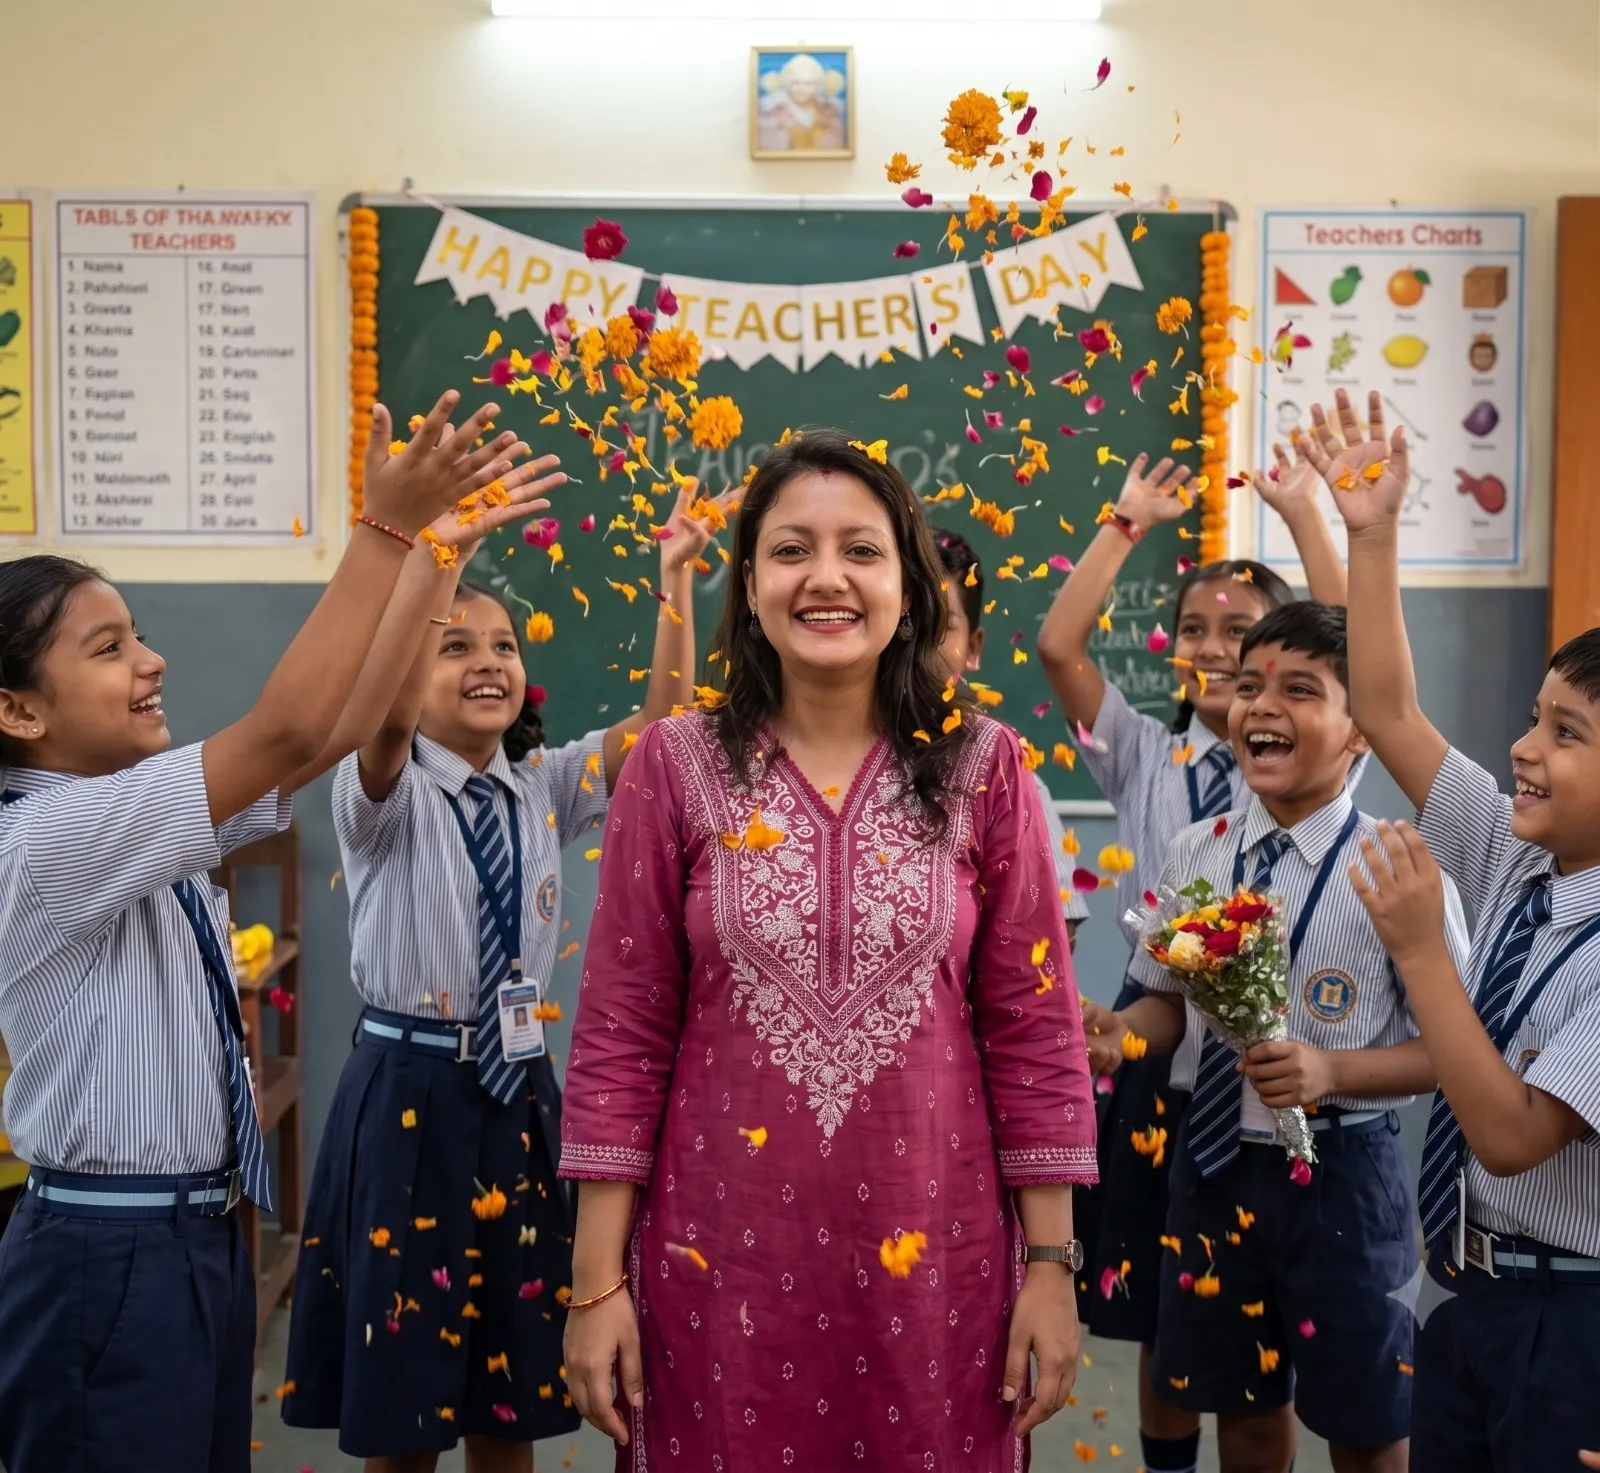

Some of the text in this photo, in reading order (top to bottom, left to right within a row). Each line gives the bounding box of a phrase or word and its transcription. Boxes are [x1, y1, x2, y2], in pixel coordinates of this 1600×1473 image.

[74, 208, 137, 226] TABLS
[143, 208, 170, 226] OF
[131, 232, 237, 250] TEACHERS
[1305, 224, 1483, 246] Teachers Charts
[436, 225, 628, 319] HAPPY
[999, 231, 1109, 306] DAY
